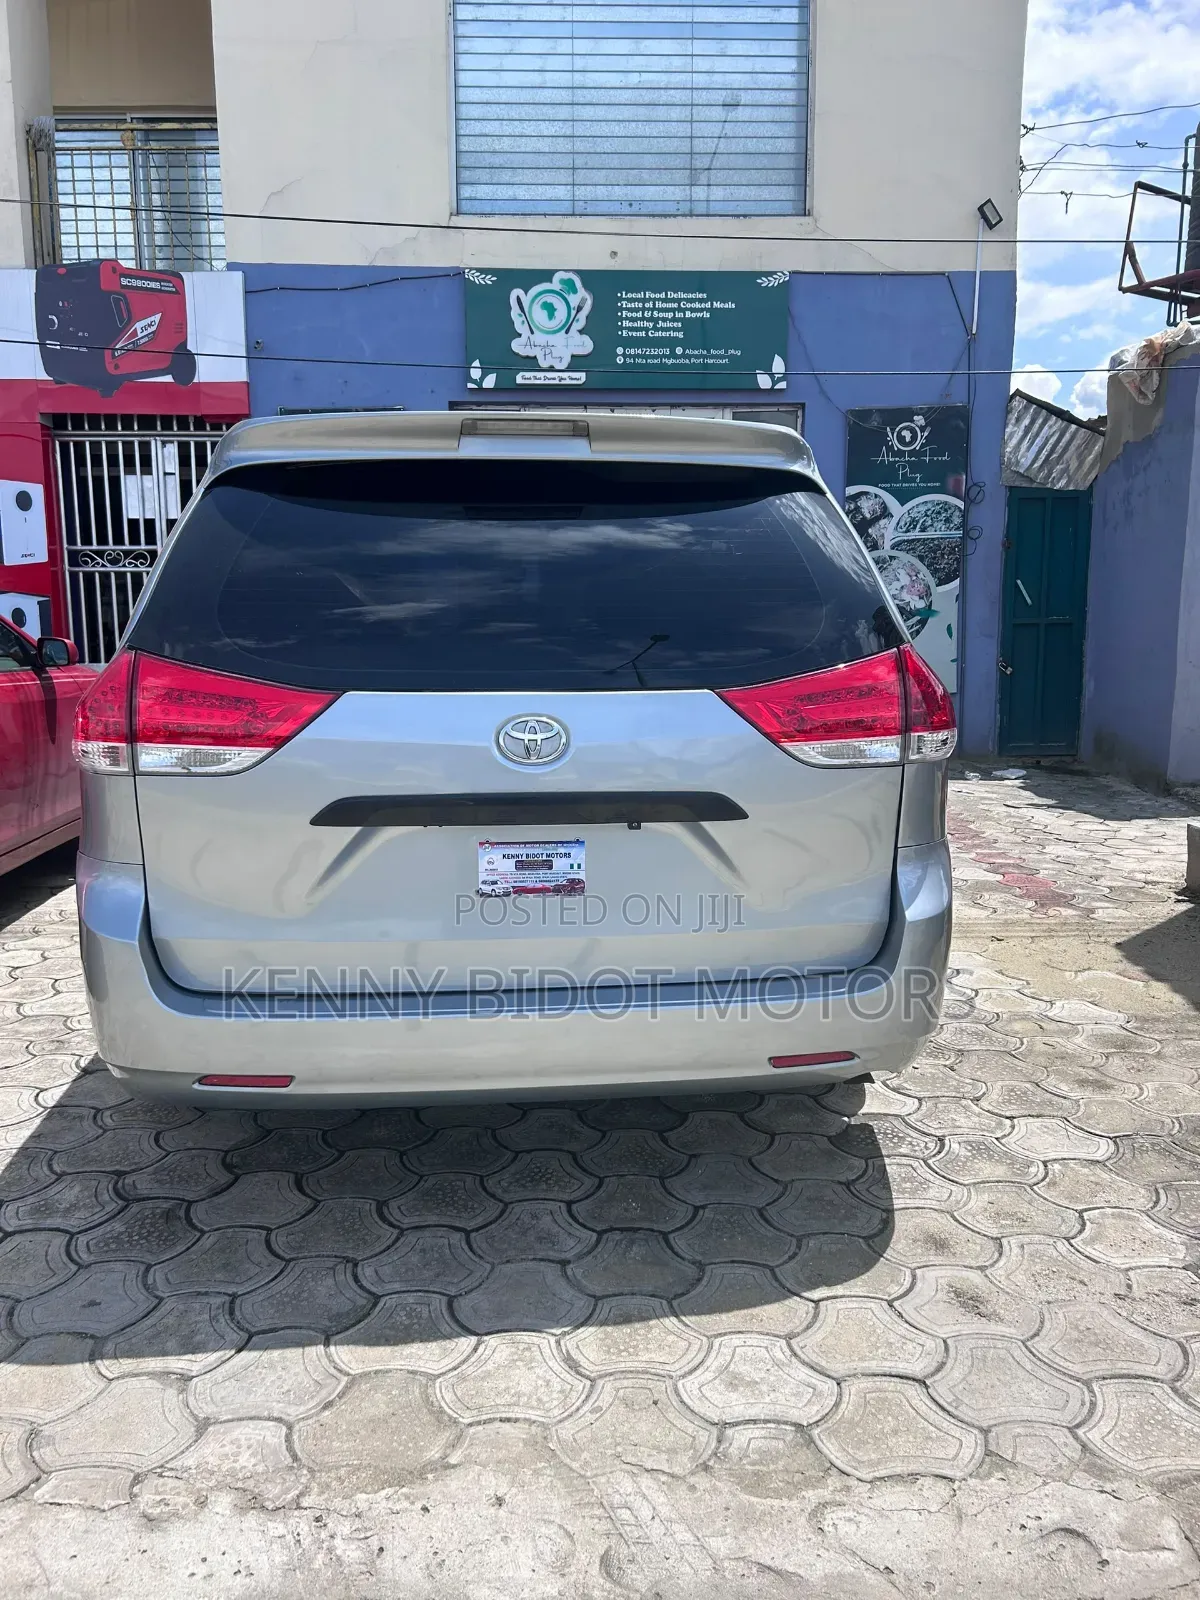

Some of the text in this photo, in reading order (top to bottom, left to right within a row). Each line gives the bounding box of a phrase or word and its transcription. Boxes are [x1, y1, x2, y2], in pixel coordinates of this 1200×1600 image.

[622, 291, 707, 299] Local Food Delicacies
[713, 301, 735, 309] Meals
[622, 310, 710, 319] Food & Soup in Bowls
[622, 320, 682, 329] Healthy Juices
[648, 330, 684, 338] Catering
[540, 347, 564, 363] Plug
[685, 348, 741, 356] Abacha_food_plug
[870, 445, 951, 465] Abacha Food
[895, 462, 923, 482] Plug
